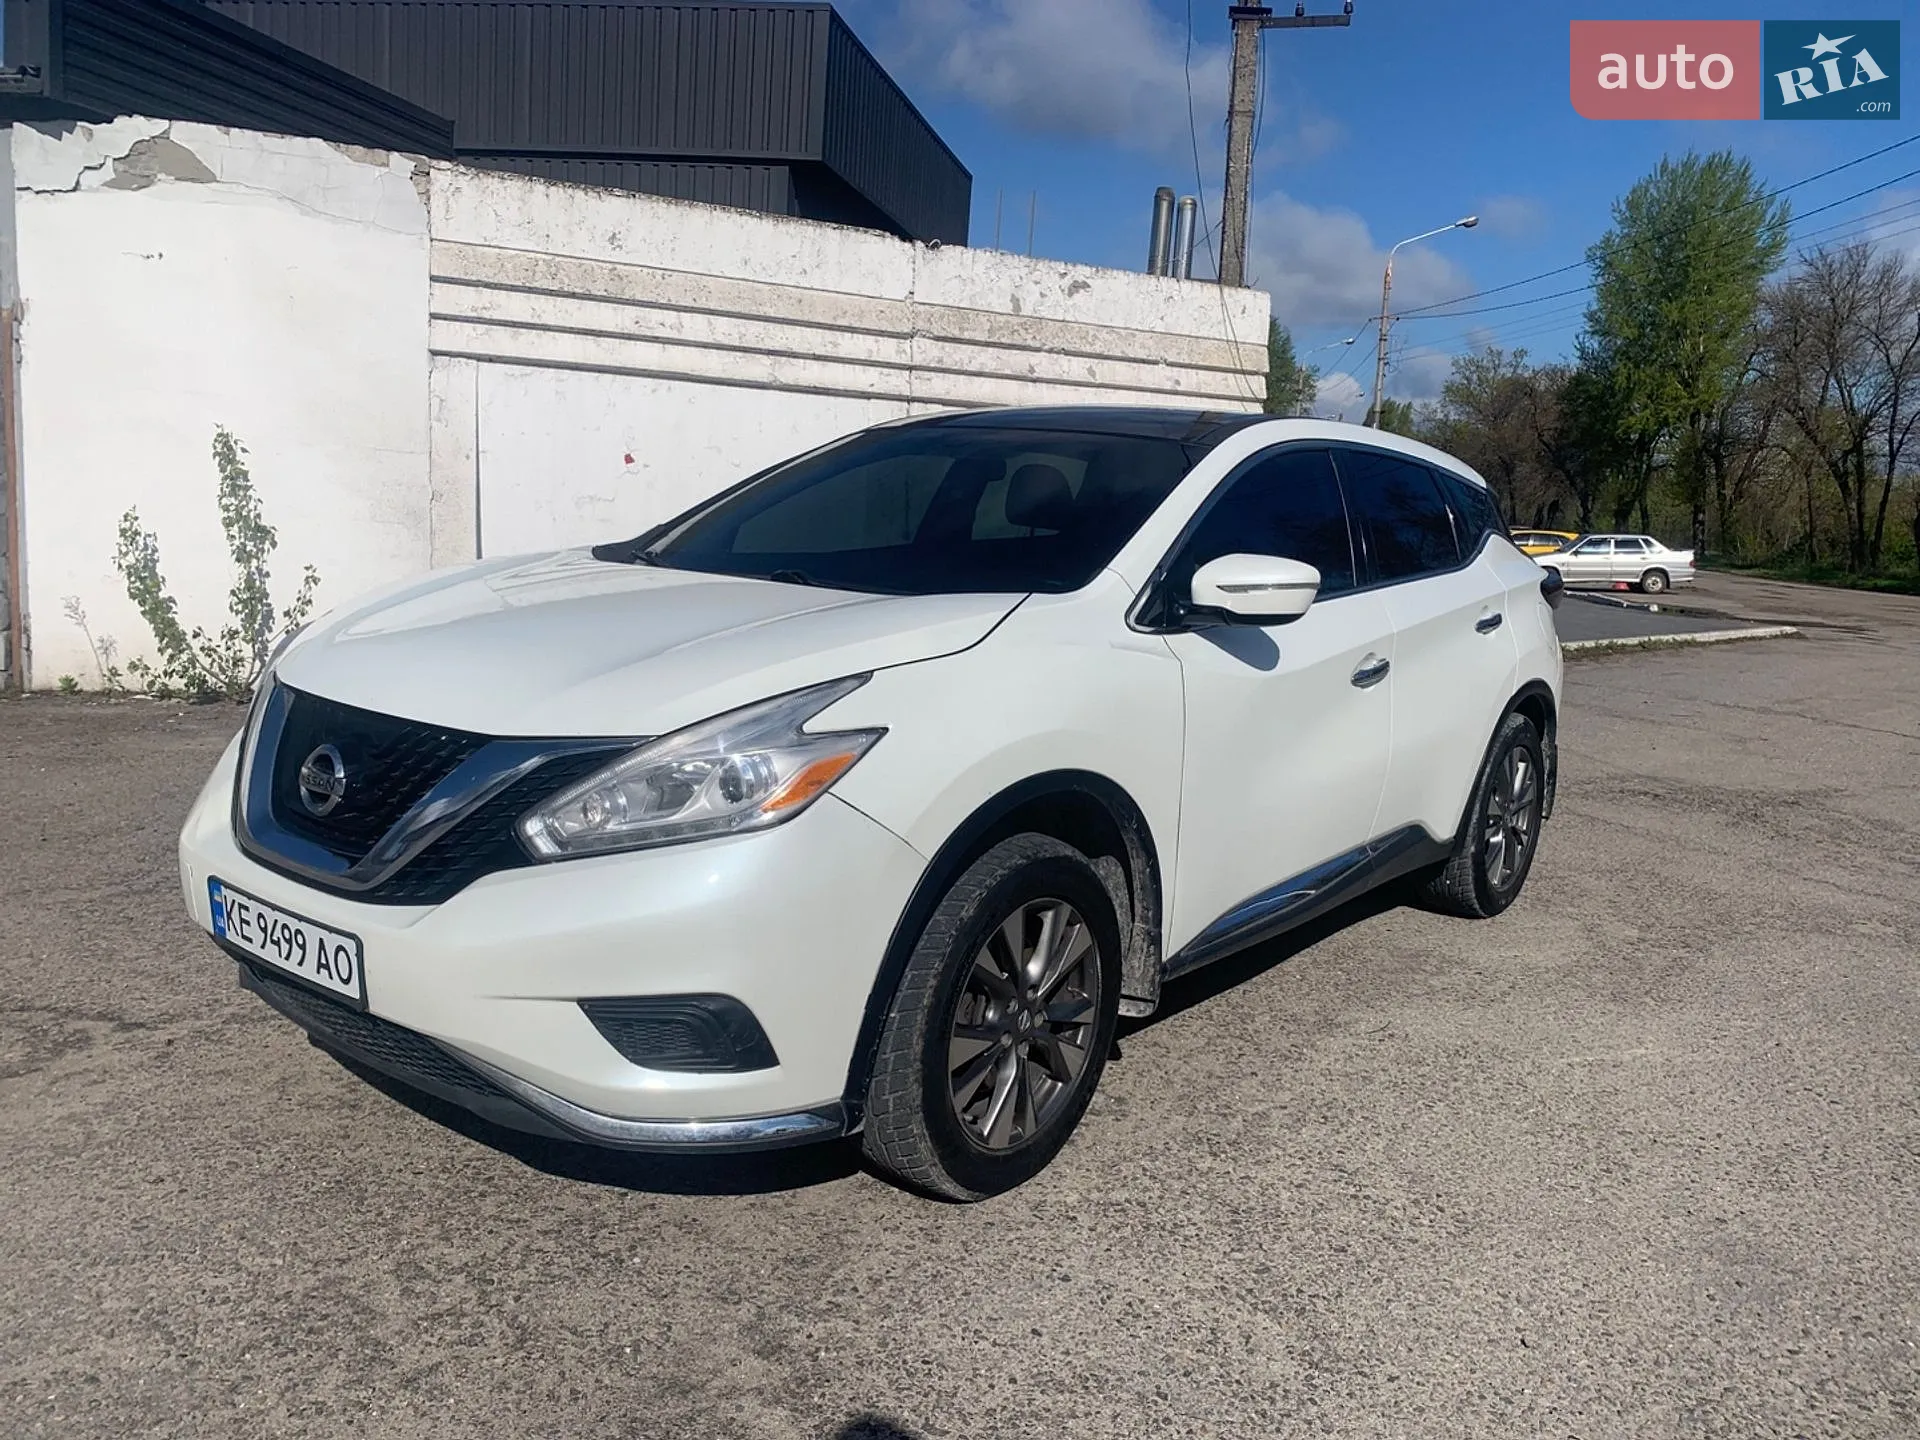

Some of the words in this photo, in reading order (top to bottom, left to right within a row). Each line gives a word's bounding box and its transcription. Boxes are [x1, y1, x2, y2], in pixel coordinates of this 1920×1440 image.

[223, 894, 253, 944] KE
[257, 912, 307, 967] 9499
[316, 937, 353, 986] AO
